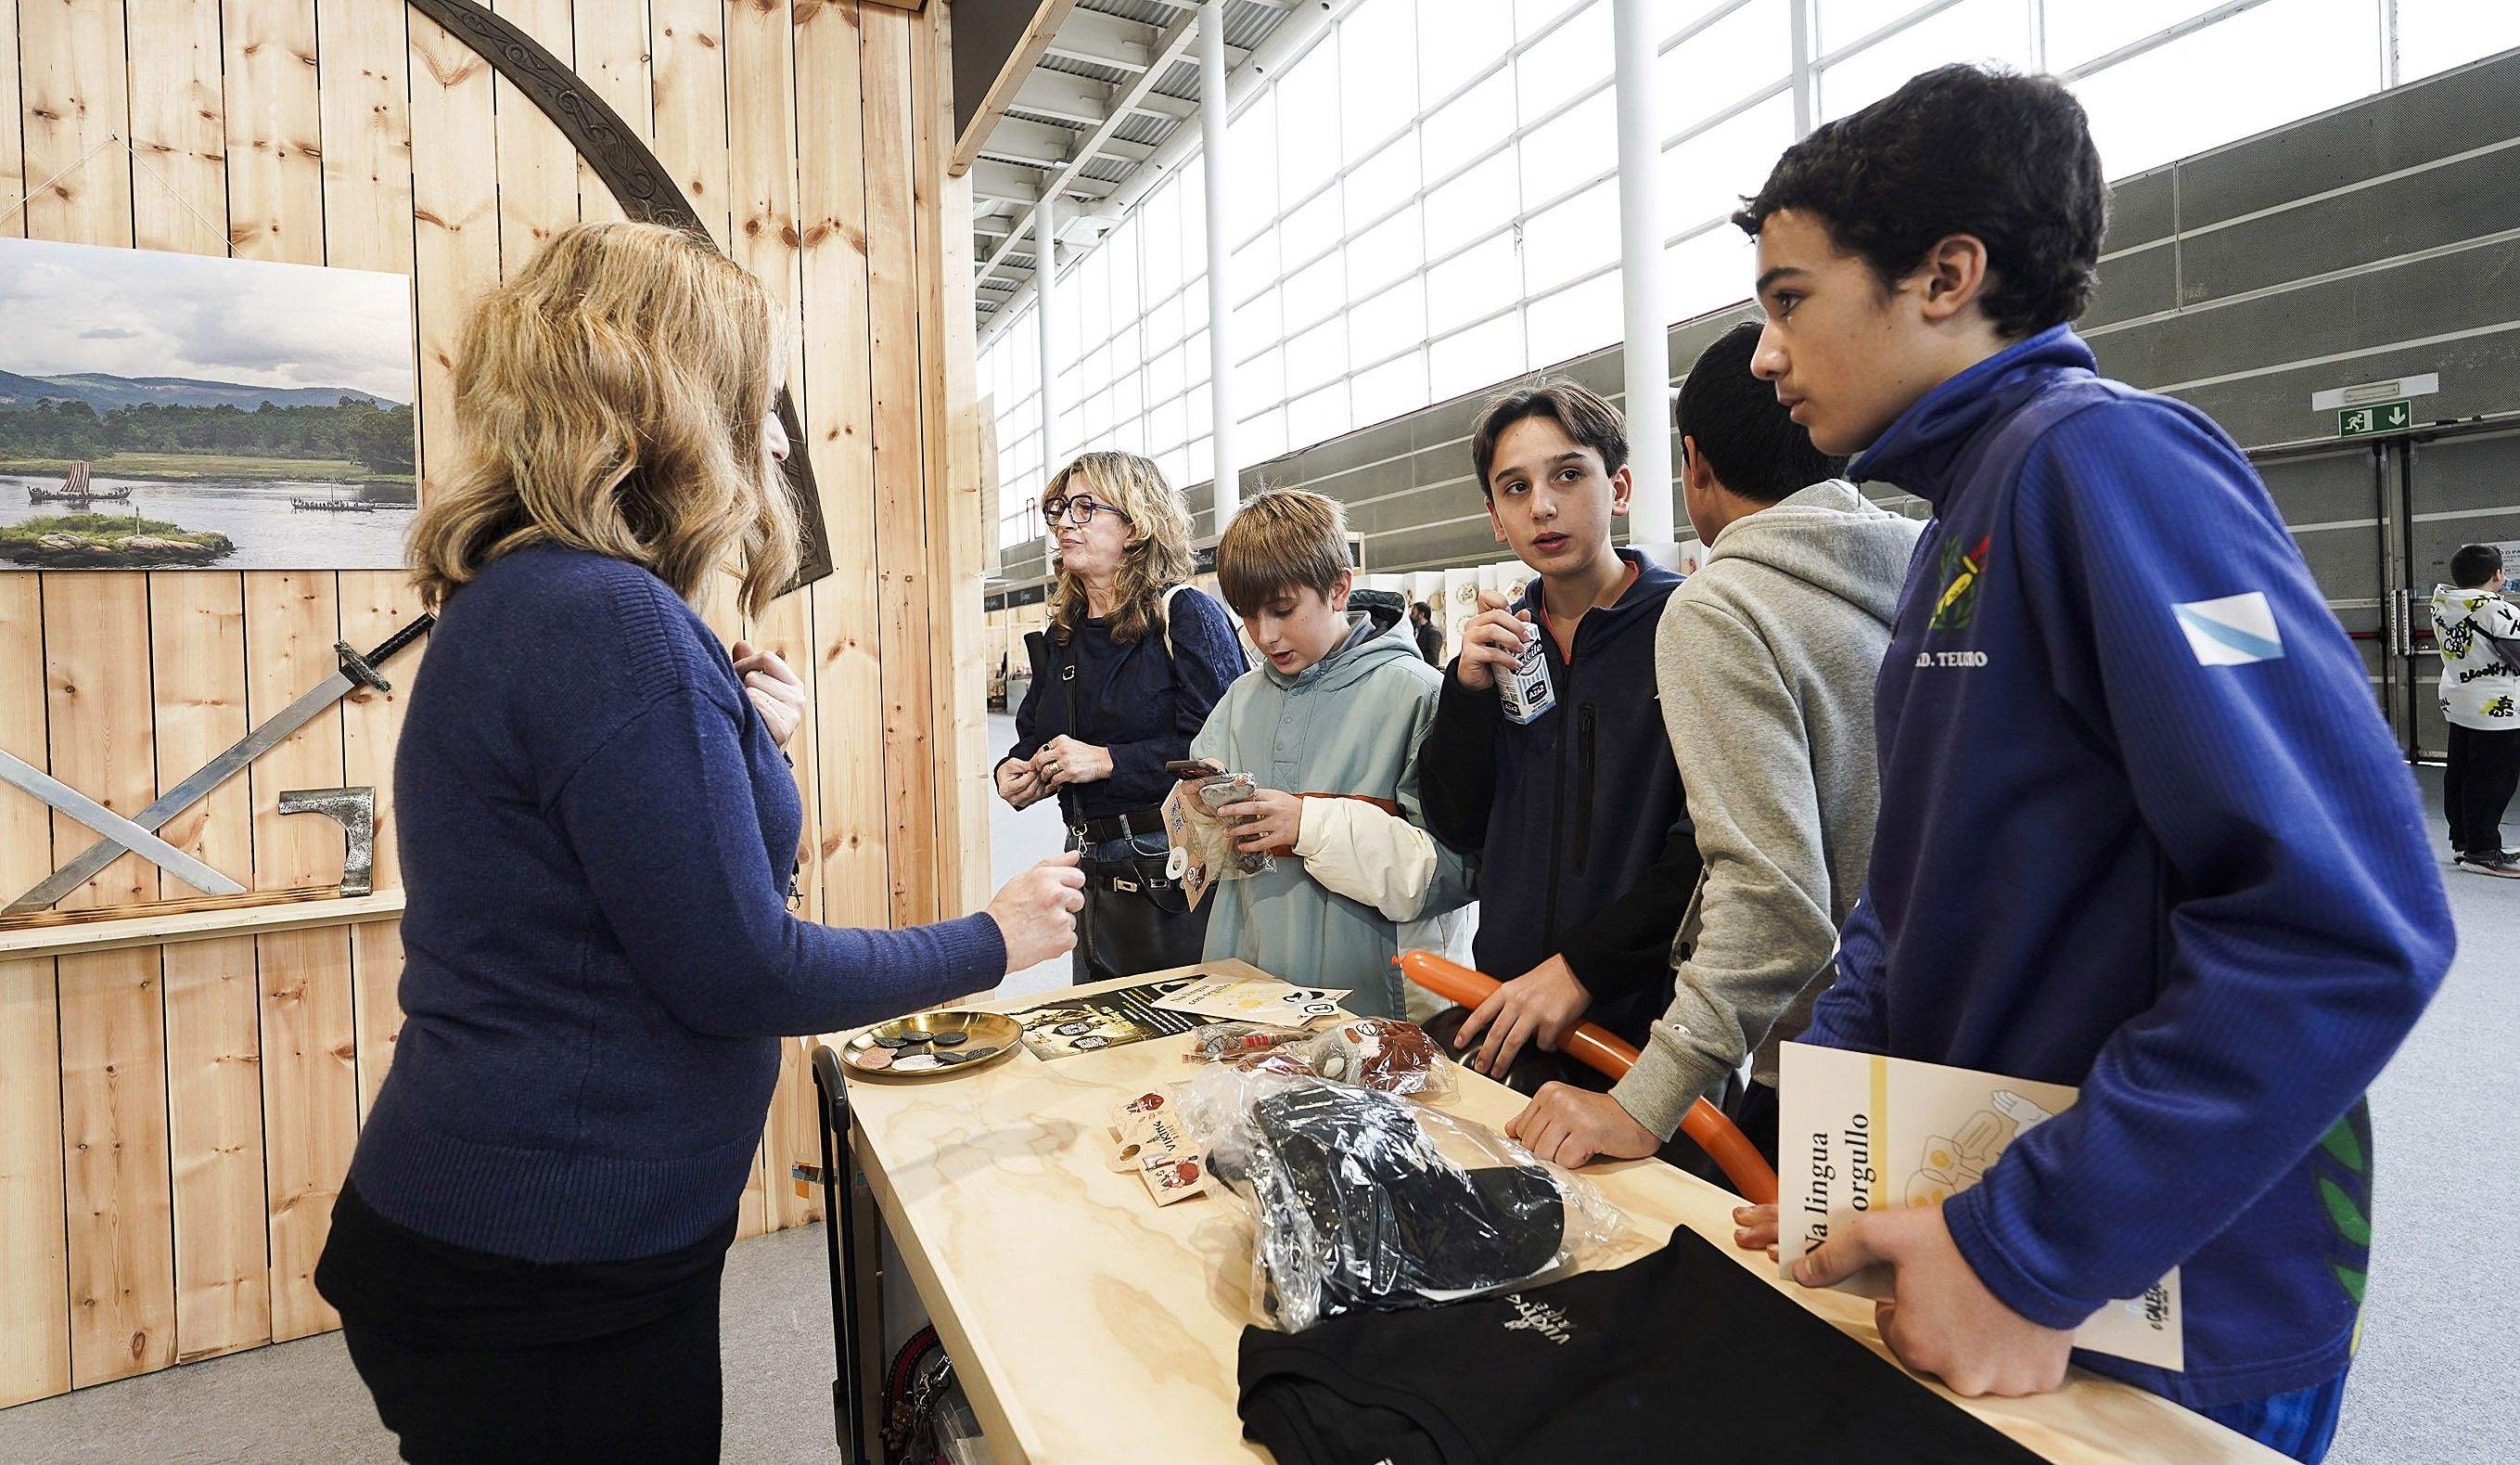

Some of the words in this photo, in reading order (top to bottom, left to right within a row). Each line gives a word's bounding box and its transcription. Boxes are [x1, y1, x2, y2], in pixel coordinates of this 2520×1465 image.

[1153, 1120, 1176, 1152] VIKING
[1804, 1132, 1836, 1216] lingua
[1844, 1113, 1876, 1212] orgullo
